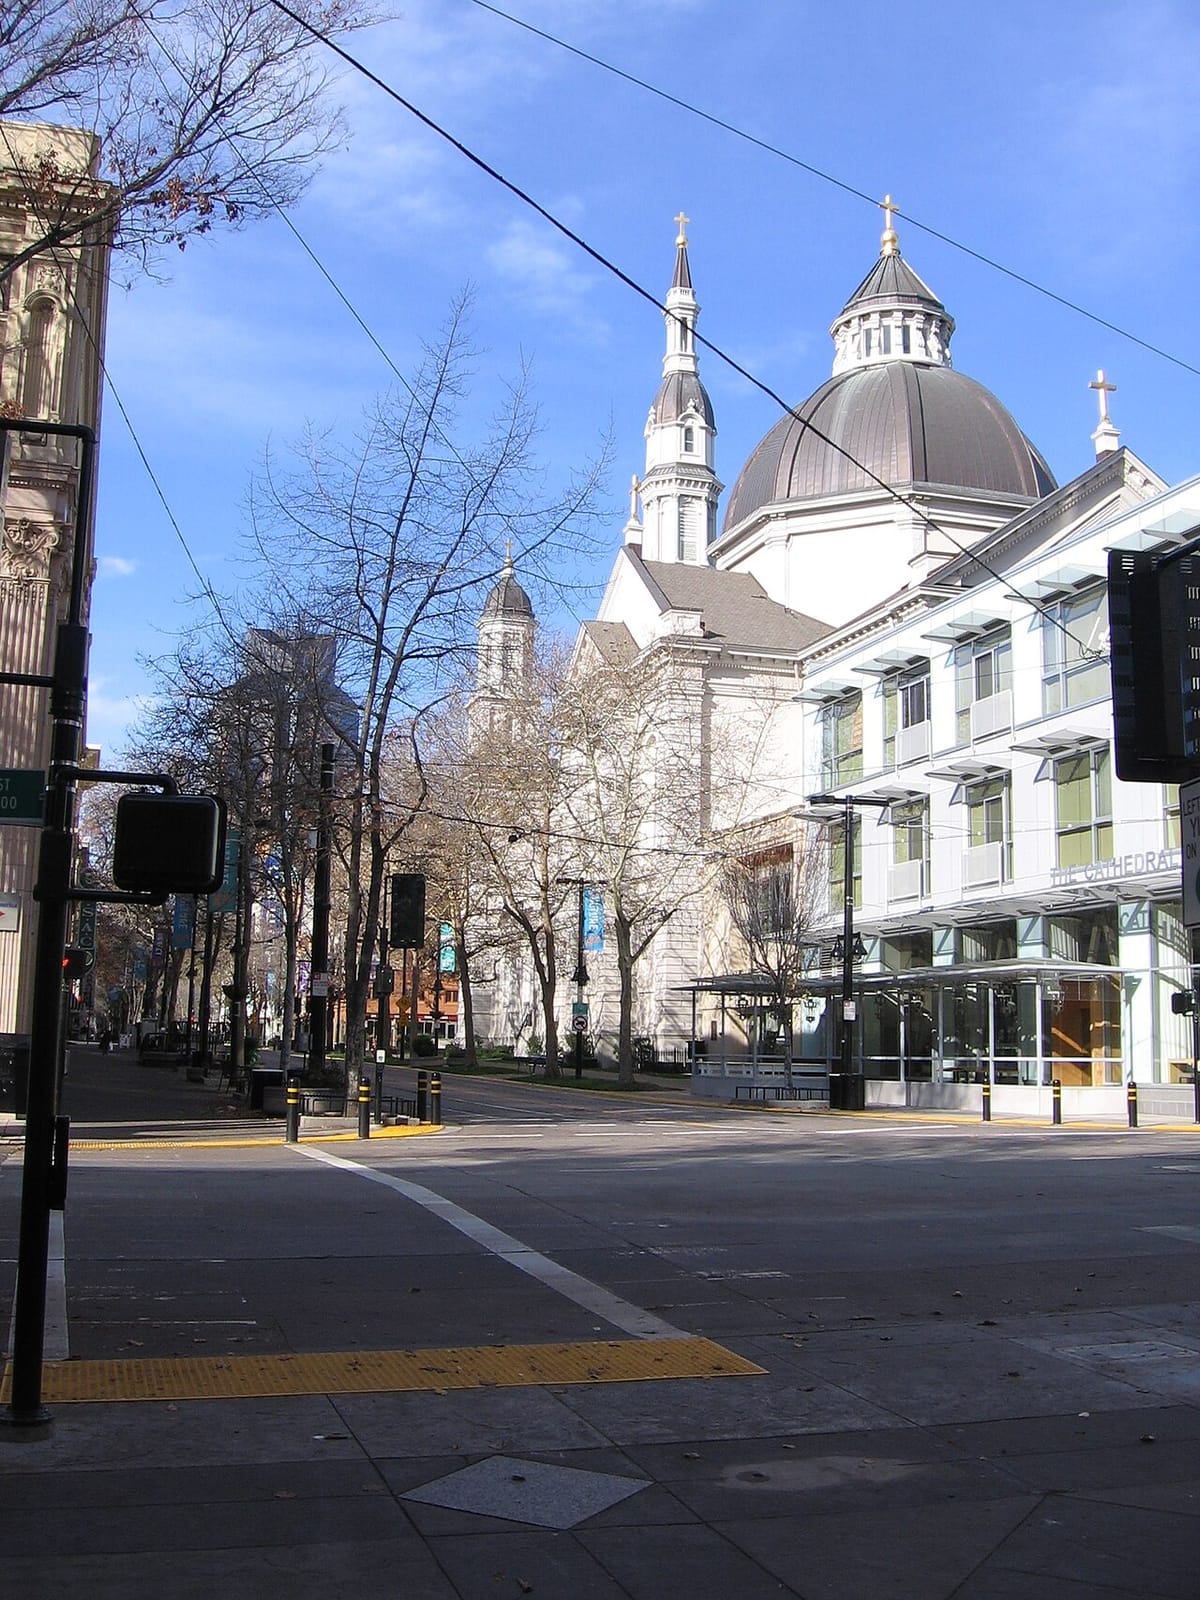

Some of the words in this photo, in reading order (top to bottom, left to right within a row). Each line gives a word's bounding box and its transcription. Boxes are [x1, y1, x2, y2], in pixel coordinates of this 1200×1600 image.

[1186, 842, 1197, 859] ON
[1050, 868, 1077, 887] THE
[1085, 849, 1178, 881] CATHEDRAL
